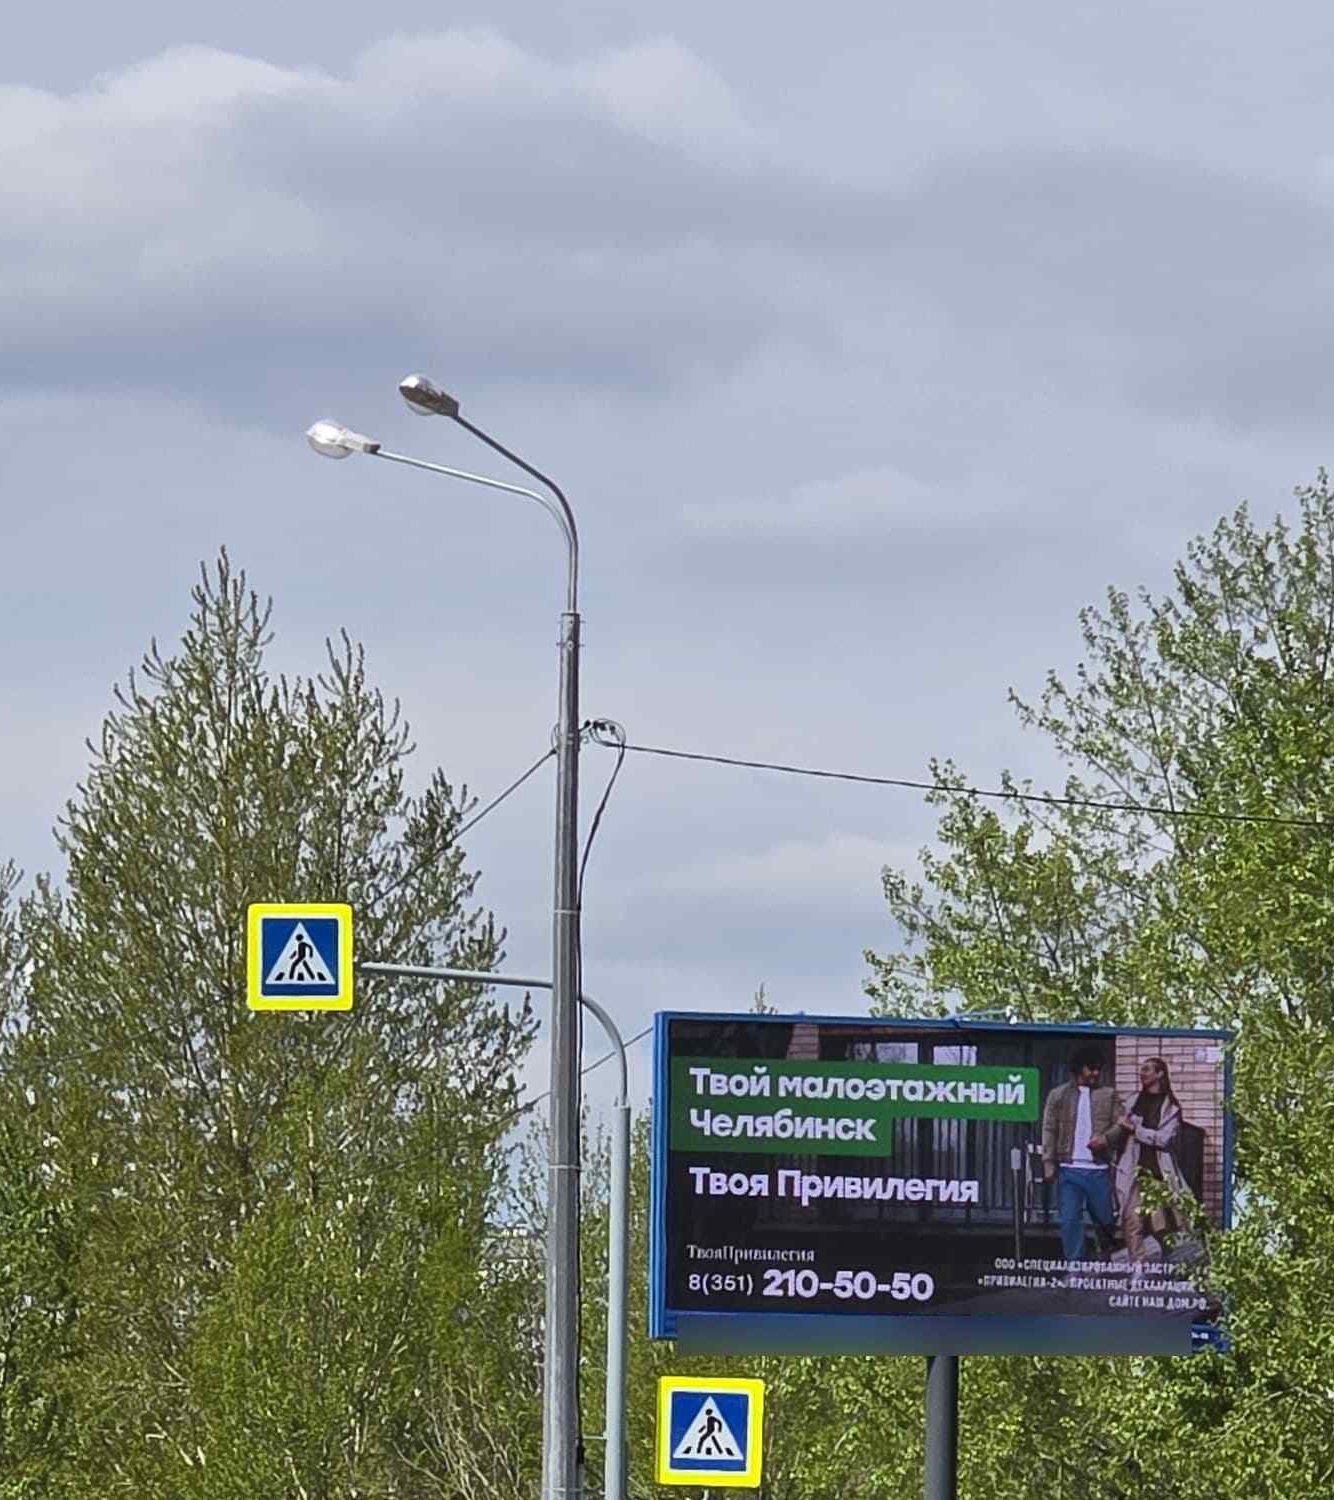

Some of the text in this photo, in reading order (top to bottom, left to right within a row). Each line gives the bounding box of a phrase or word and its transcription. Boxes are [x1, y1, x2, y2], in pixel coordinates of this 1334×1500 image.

[689, 1066, 1025, 1105] Твой малоэтажный
[689, 1108, 877, 1142] Челябинск
[689, 1167, 979, 1206] Твоя Привилегия
[686, 1244, 816, 1265] ТвояПривилегия
[688, 1268, 935, 1301] 8(351) 210-50-50
